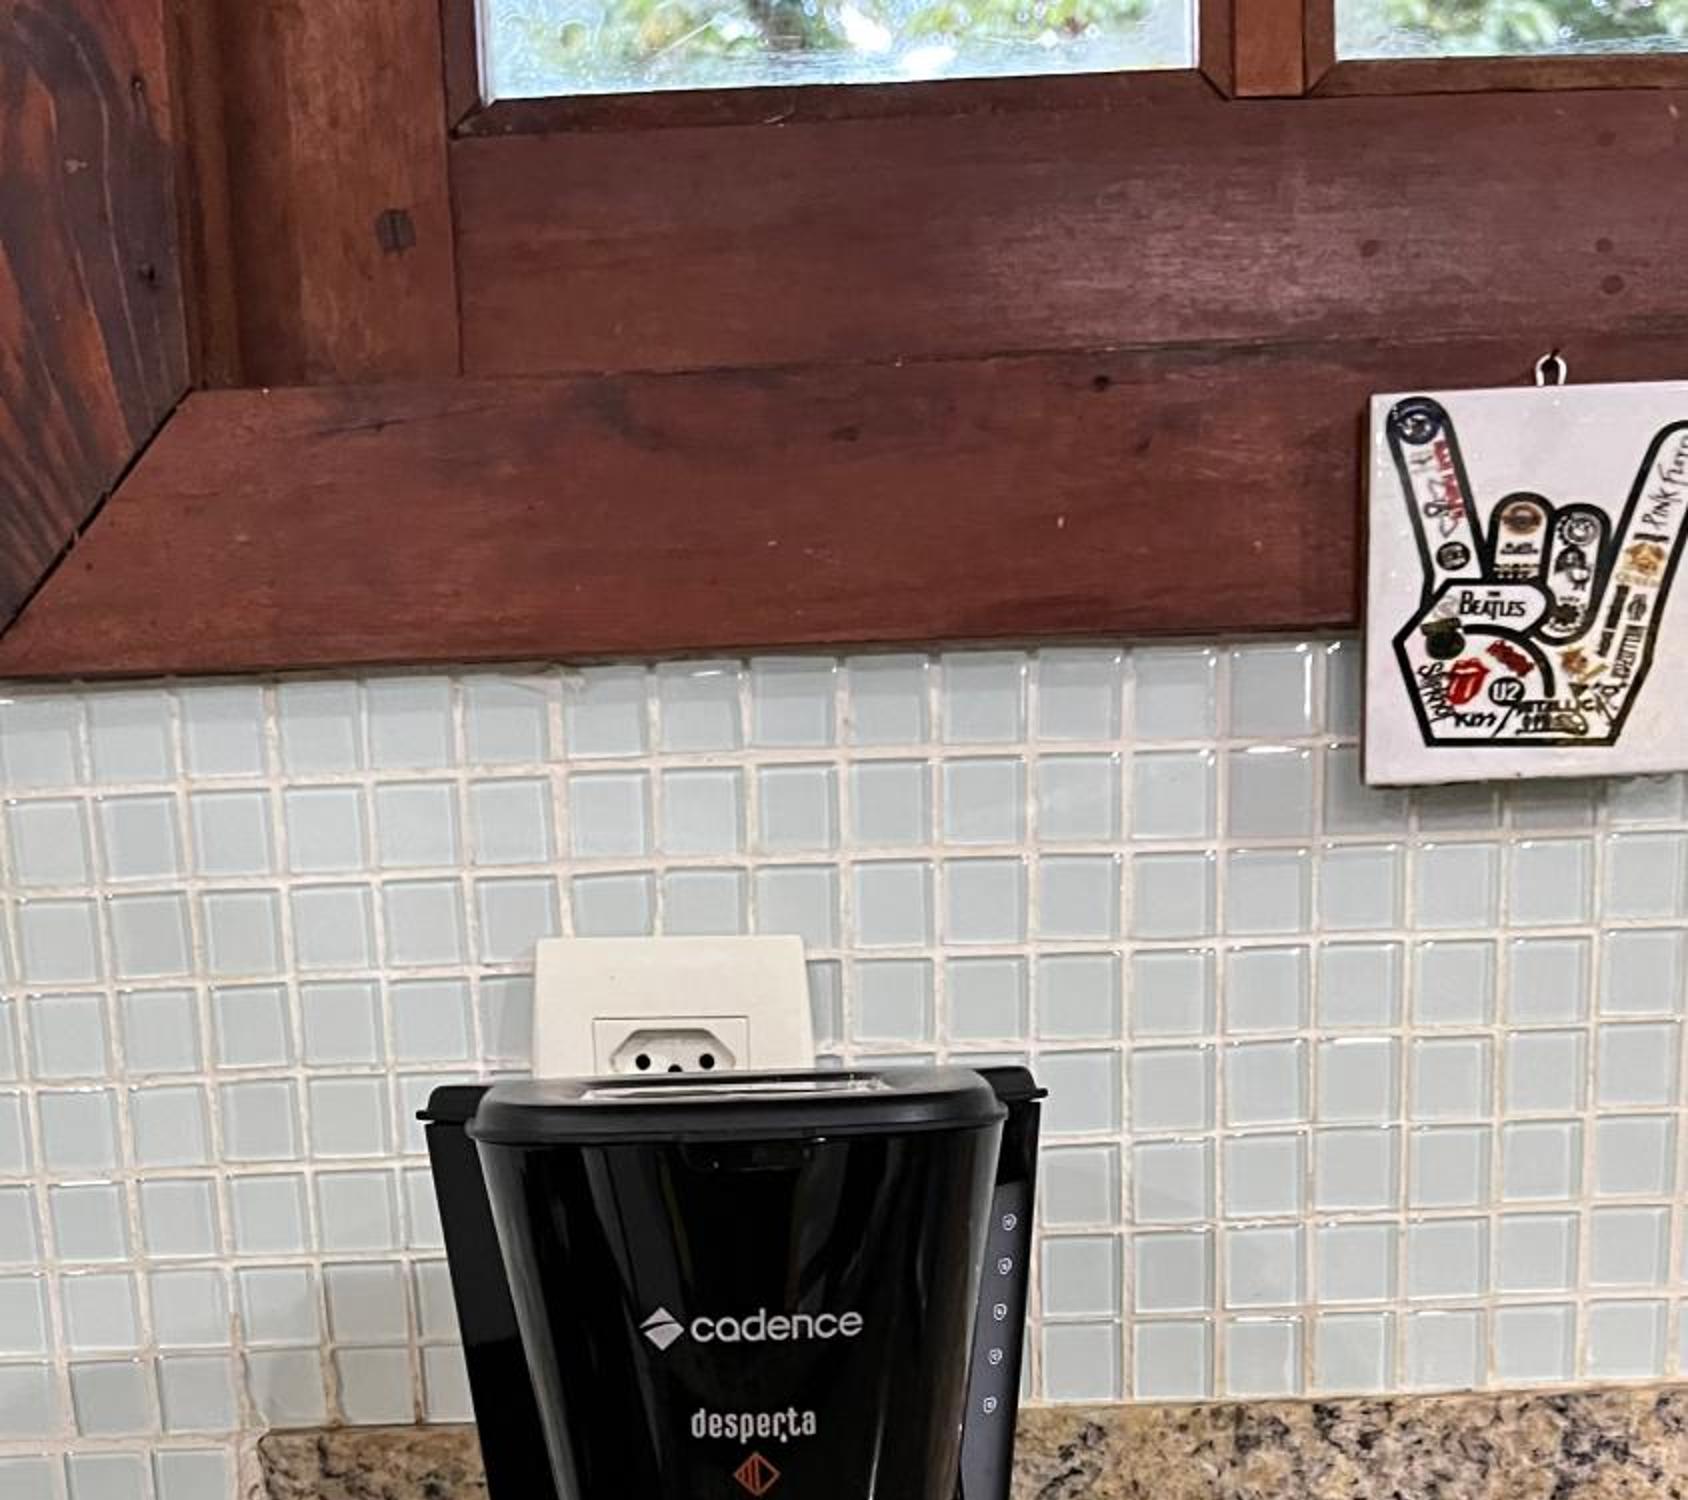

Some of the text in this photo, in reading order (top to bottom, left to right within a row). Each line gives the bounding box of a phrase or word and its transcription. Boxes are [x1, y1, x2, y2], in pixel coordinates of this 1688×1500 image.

[1459, 591, 1526, 620] BEATLES
[1492, 682, 1521, 701] U2
[690, 1307, 864, 1343] cadence
[690, 1407, 817, 1444] desperta
